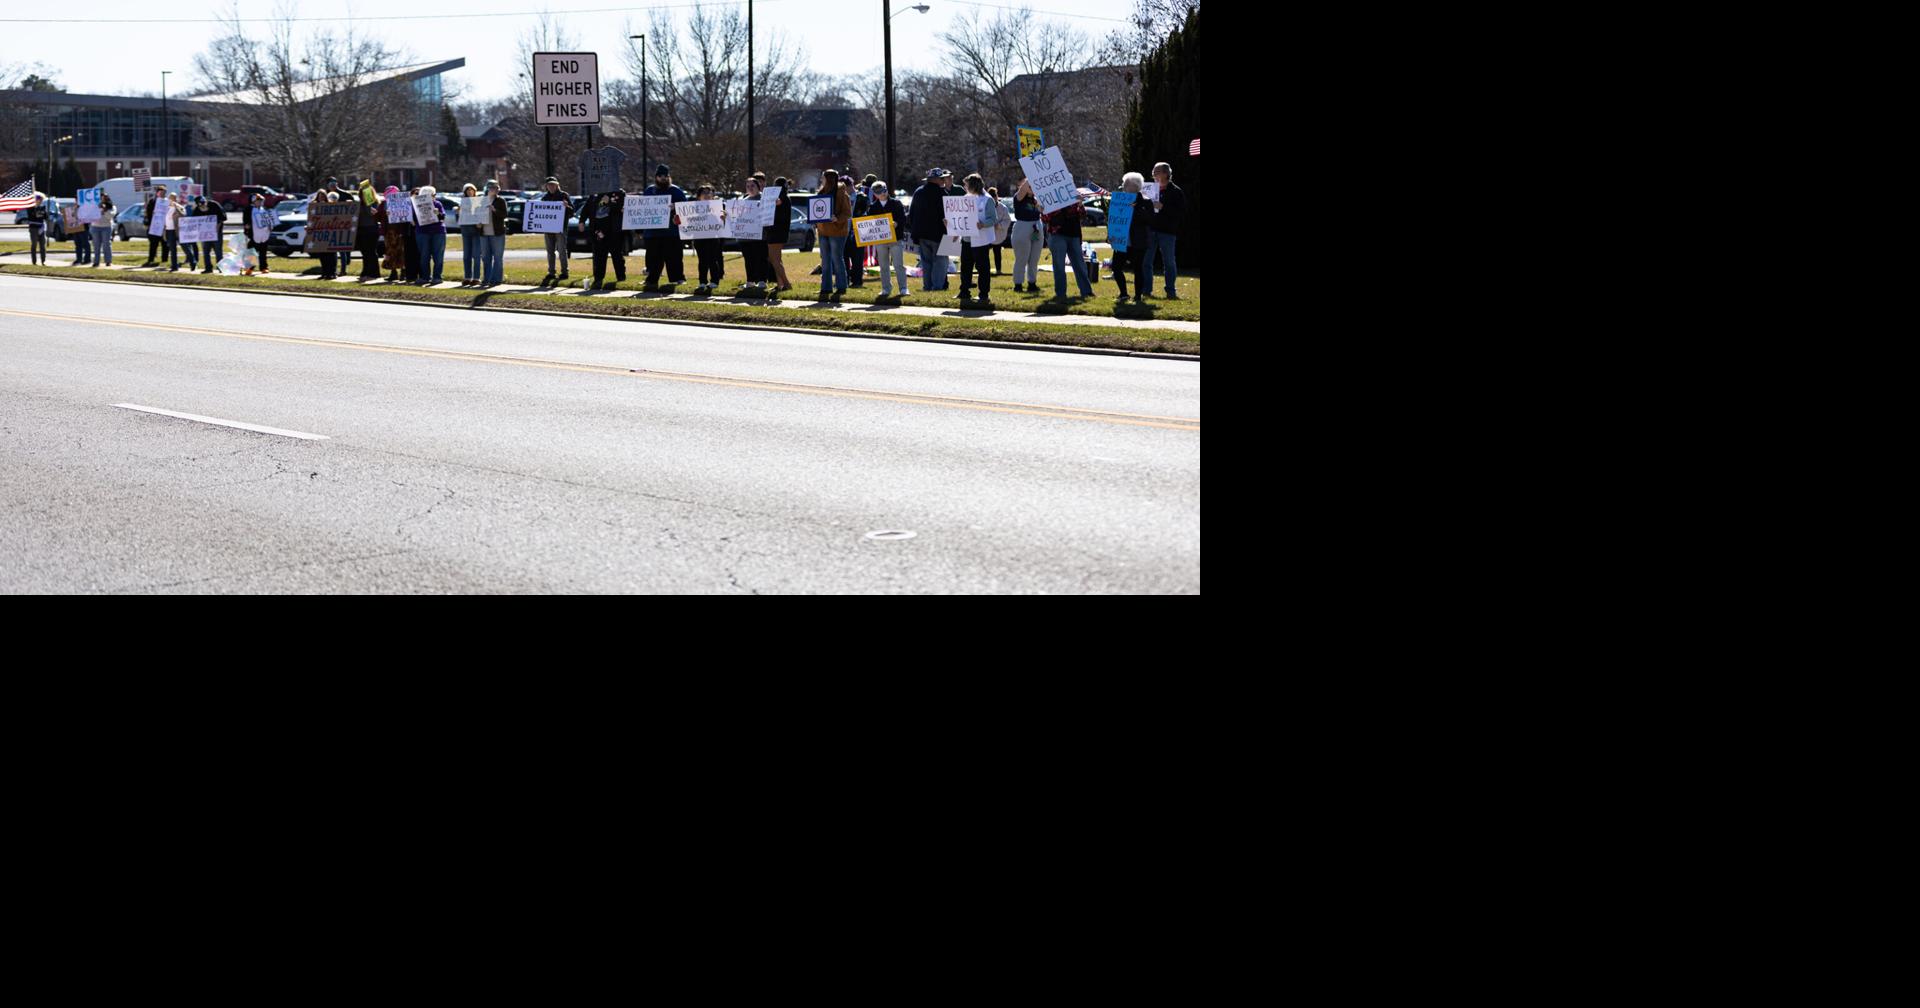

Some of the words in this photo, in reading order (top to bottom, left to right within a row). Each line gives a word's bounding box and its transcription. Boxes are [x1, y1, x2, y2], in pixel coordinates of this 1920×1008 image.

[552, 60, 579, 74] END
[540, 82, 592, 95] HIGHER
[547, 103, 587, 117] FINES
[1033, 156, 1052, 173] NO
[1033, 169, 1066, 190] SECRET
[79, 188, 100, 204] ICE
[638, 198, 650, 206] NOT
[653, 197, 669, 205] TURN
[1038, 182, 1078, 208] POLICE
[315, 205, 348, 215] LIBERTY
[644, 208, 659, 216] BACK
[660, 208, 669, 216] ON
[945, 198, 975, 213] ABOLISH
[528, 212, 557, 220] CALLOUS
[952, 216, 970, 230] ICE
[313, 231, 329, 241] FOR
[329, 231, 352, 246] ALL
